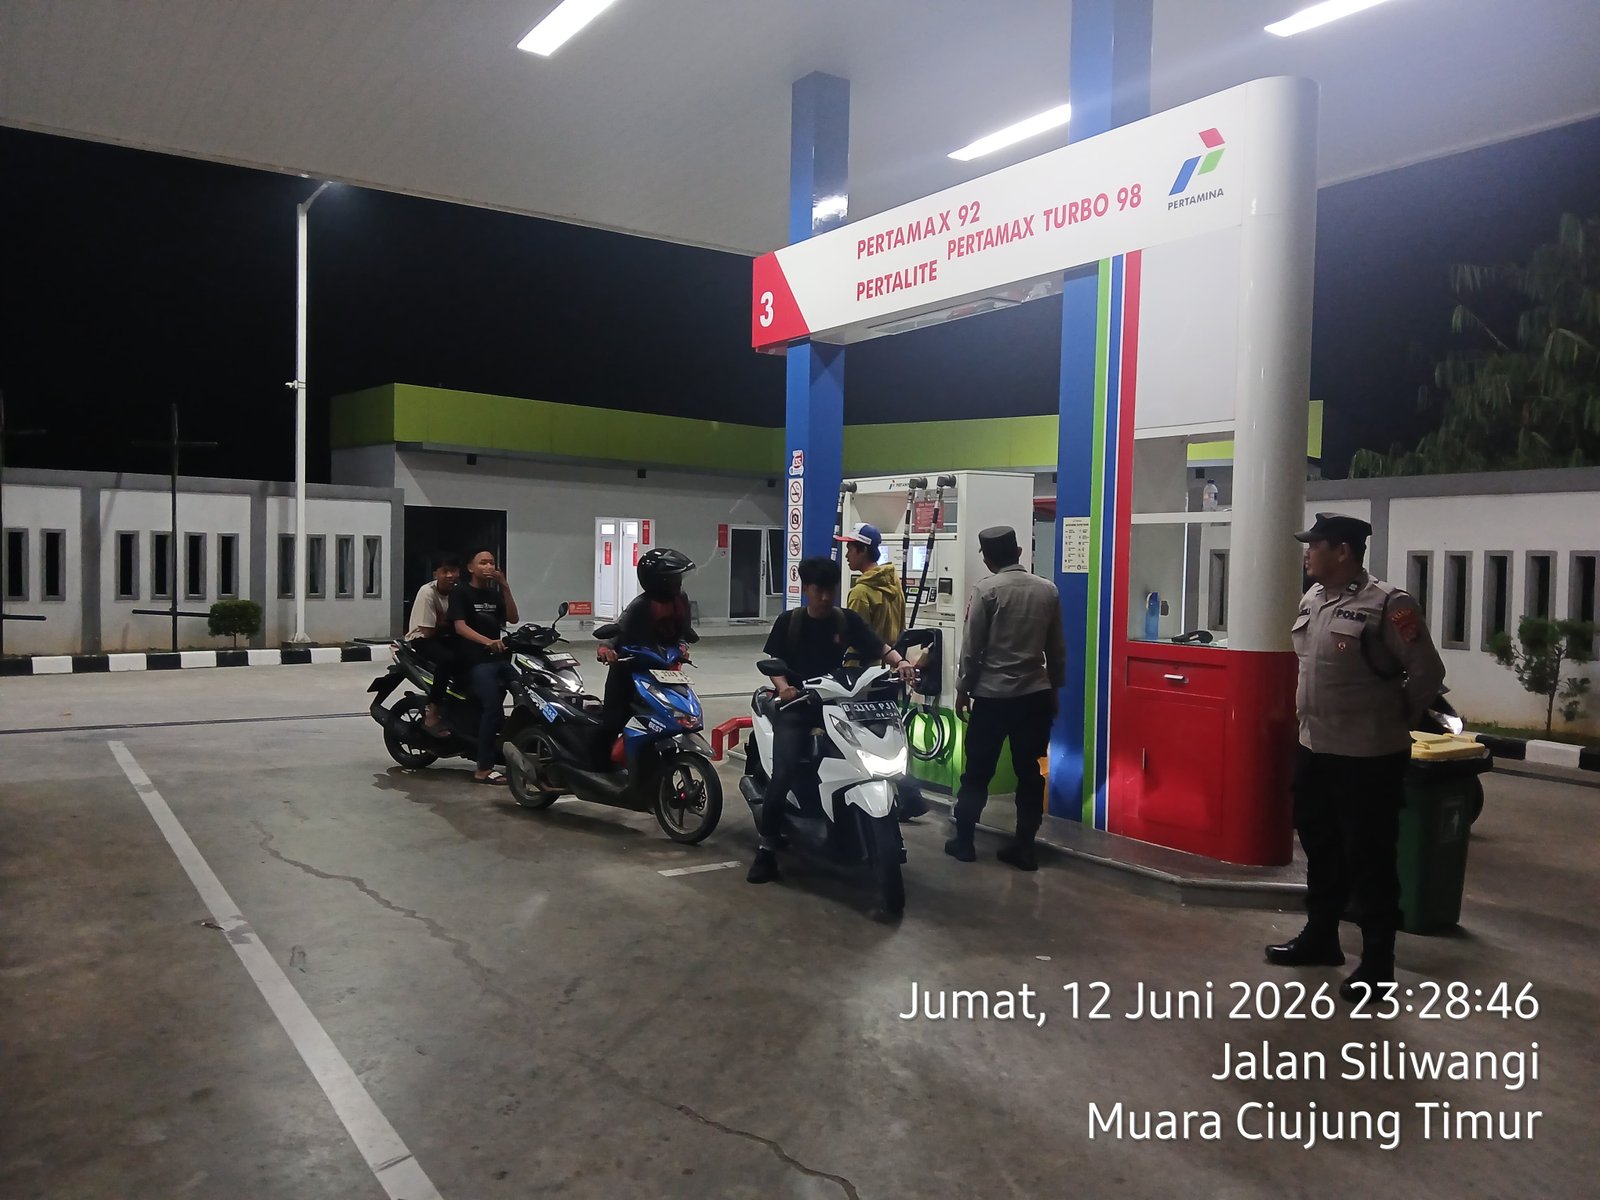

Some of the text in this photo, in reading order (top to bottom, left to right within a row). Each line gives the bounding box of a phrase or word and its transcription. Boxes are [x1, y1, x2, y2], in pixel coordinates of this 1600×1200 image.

[1167, 188, 1224, 211] PERTAMINA
[857, 200, 981, 260] PERTAMAX 92
[947, 183, 1142, 261] PERTAMAX TURBO 98
[856, 259, 938, 302] PERTALITE
[759, 291, 774, 328] 3
